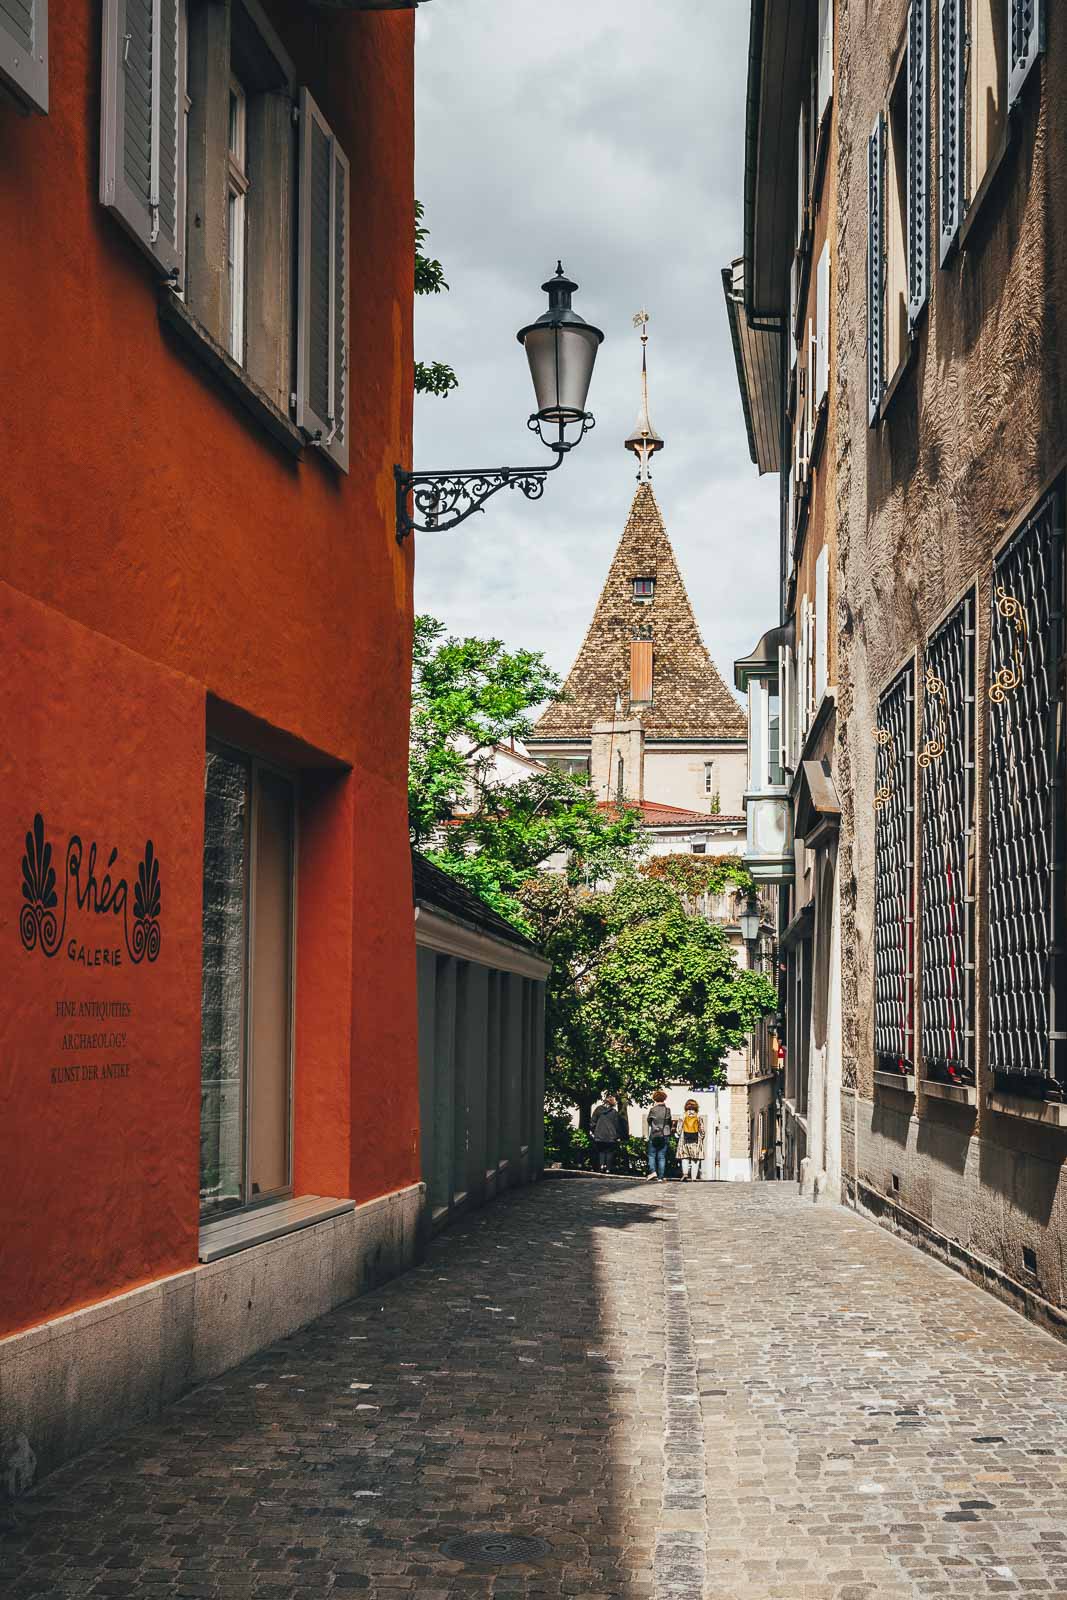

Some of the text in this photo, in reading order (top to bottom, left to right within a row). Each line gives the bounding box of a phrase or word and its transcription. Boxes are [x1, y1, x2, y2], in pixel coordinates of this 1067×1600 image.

[67, 939, 121, 966] GALERIE
[56, 1001, 131, 1021] FINE ANTIQUITIES
[62, 1032, 127, 1049] ARCHAEOLOGY
[51, 1066, 80, 1084] KUNST
[82, 1065, 98, 1080] DER
